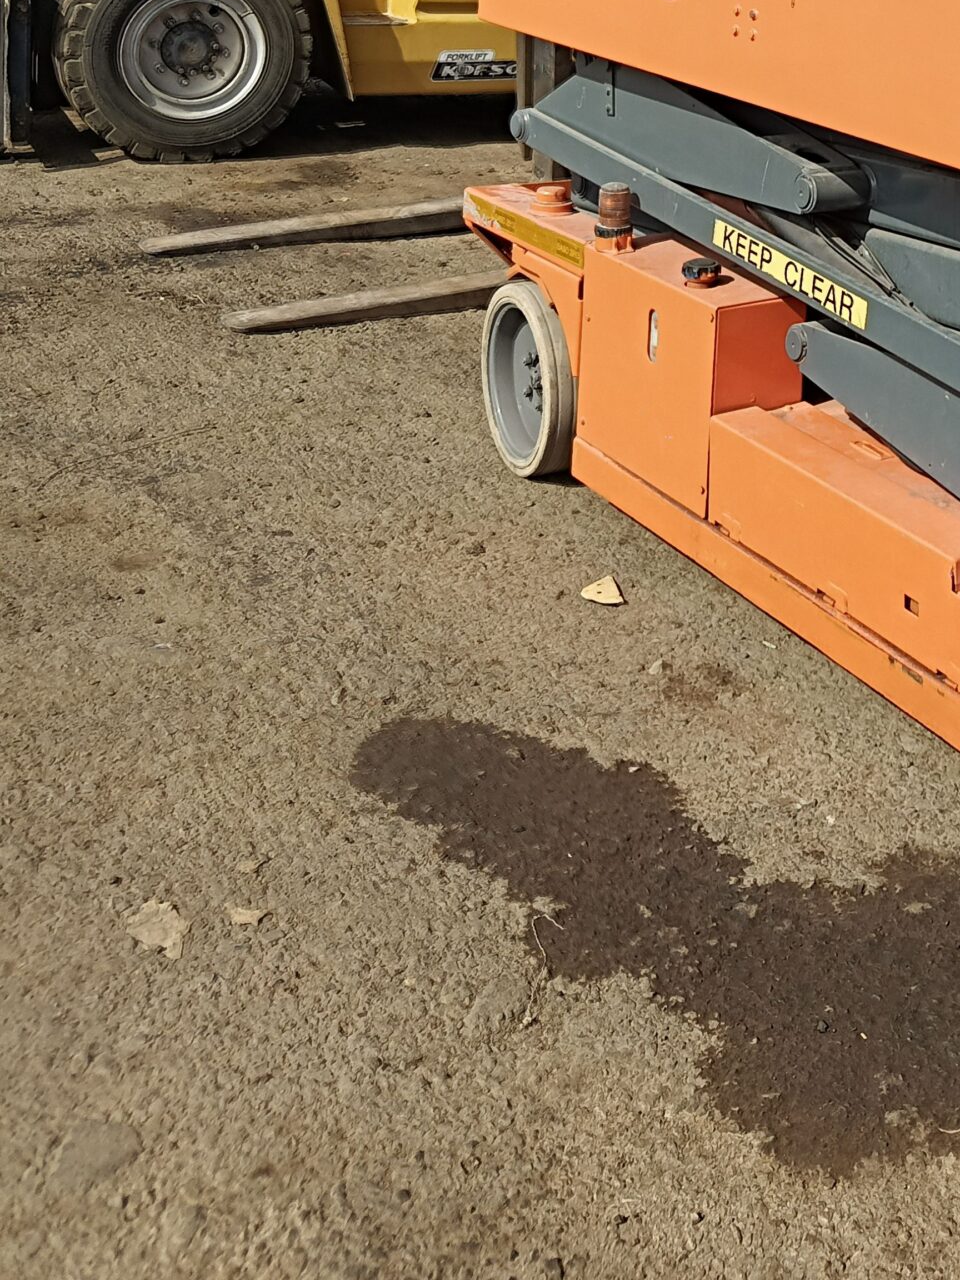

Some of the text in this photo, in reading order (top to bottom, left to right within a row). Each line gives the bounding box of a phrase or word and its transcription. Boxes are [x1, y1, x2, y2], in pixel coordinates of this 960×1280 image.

[445, 53, 489, 62] FORKLIFT
[722, 225, 855, 323] KEEP CLEAR
